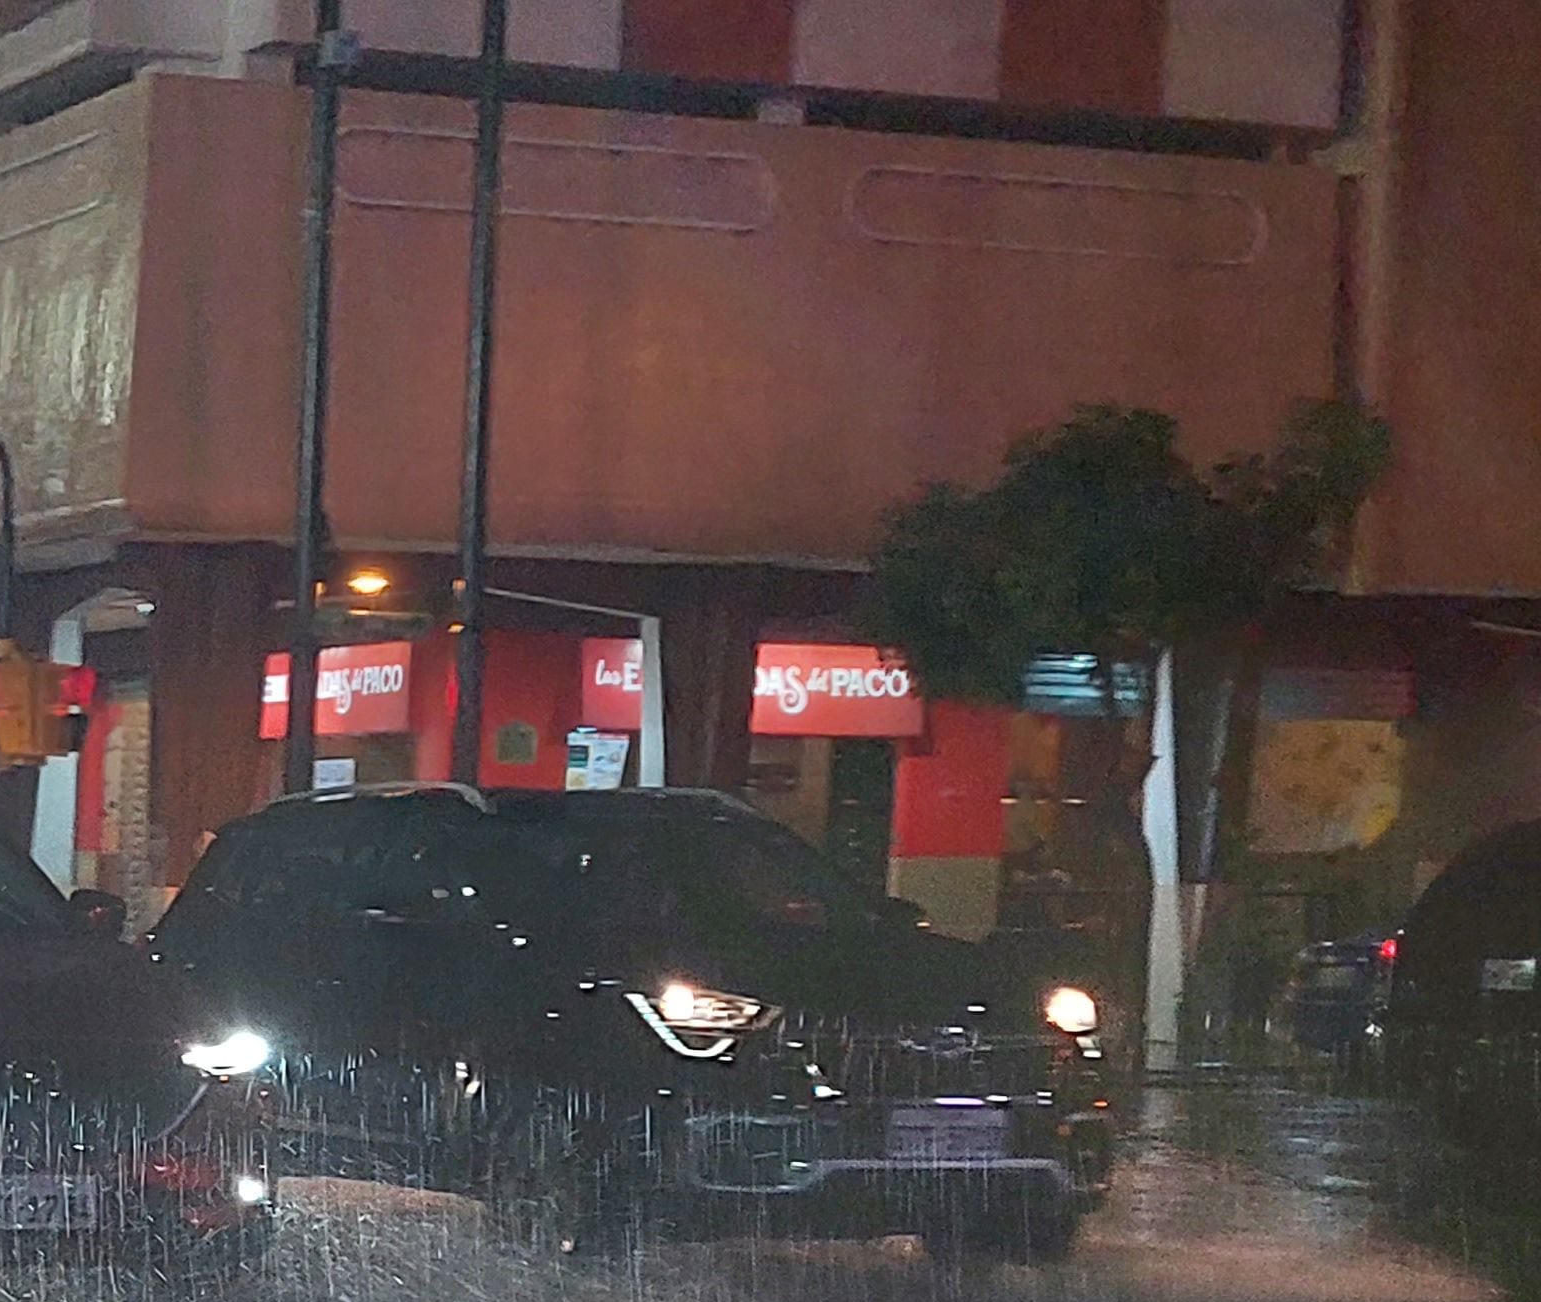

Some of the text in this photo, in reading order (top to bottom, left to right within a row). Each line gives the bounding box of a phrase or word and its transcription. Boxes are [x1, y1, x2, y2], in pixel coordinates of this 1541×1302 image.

[361, 664, 403, 695] PACO
[622, 662, 643, 691] E
[753, 665, 808, 715] DAS
[830, 667, 910, 698] PACO
